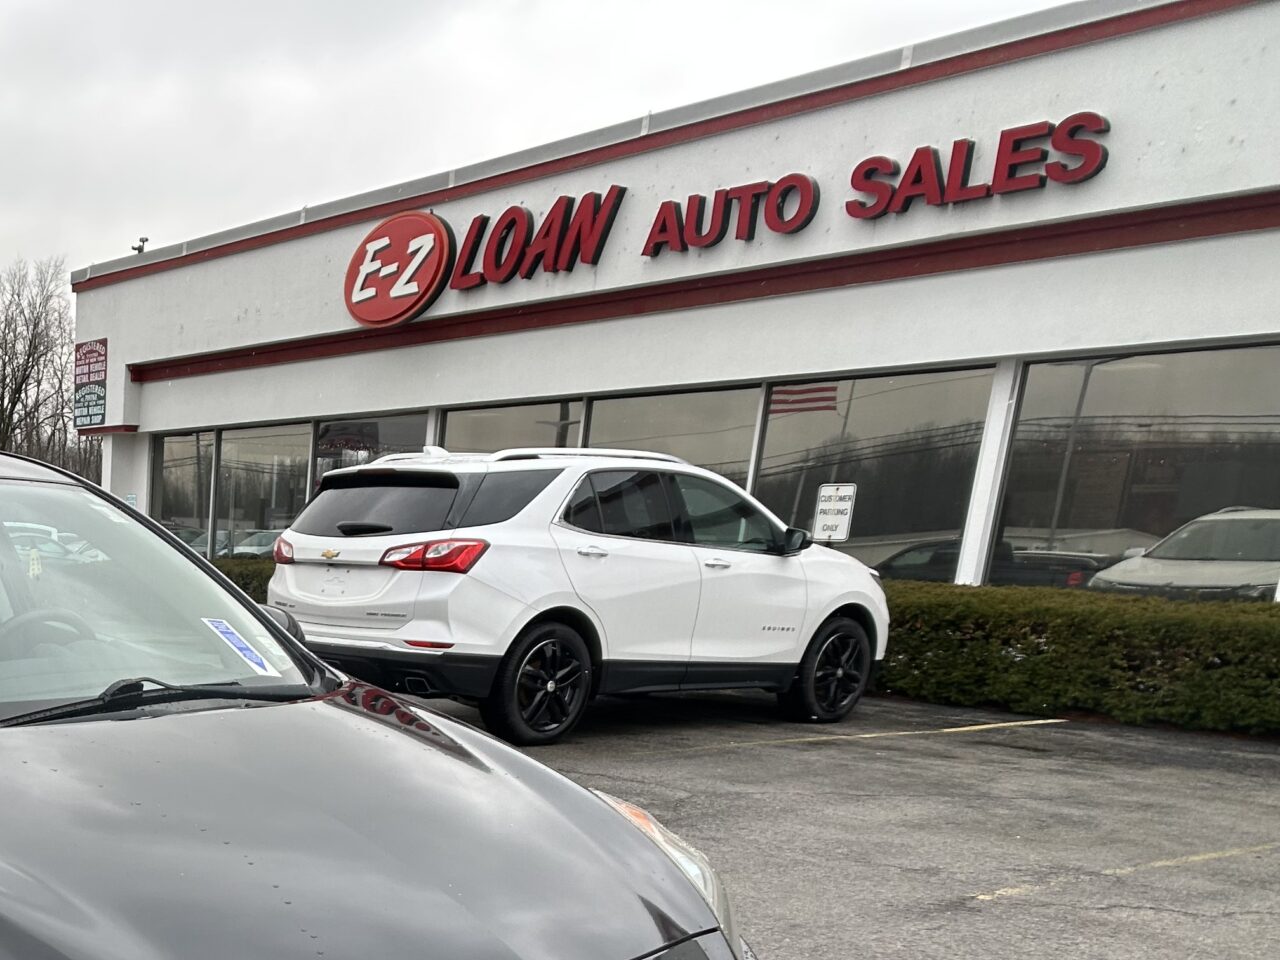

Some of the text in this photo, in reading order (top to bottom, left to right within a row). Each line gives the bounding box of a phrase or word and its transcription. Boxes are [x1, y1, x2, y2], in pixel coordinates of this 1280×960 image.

[351, 111, 1111, 304] E-Z LOAN AUTO SALES
[820, 494, 853, 503] CUSTOMER
[819, 508, 849, 516] PARKING
[822, 523, 840, 532] ONLY
